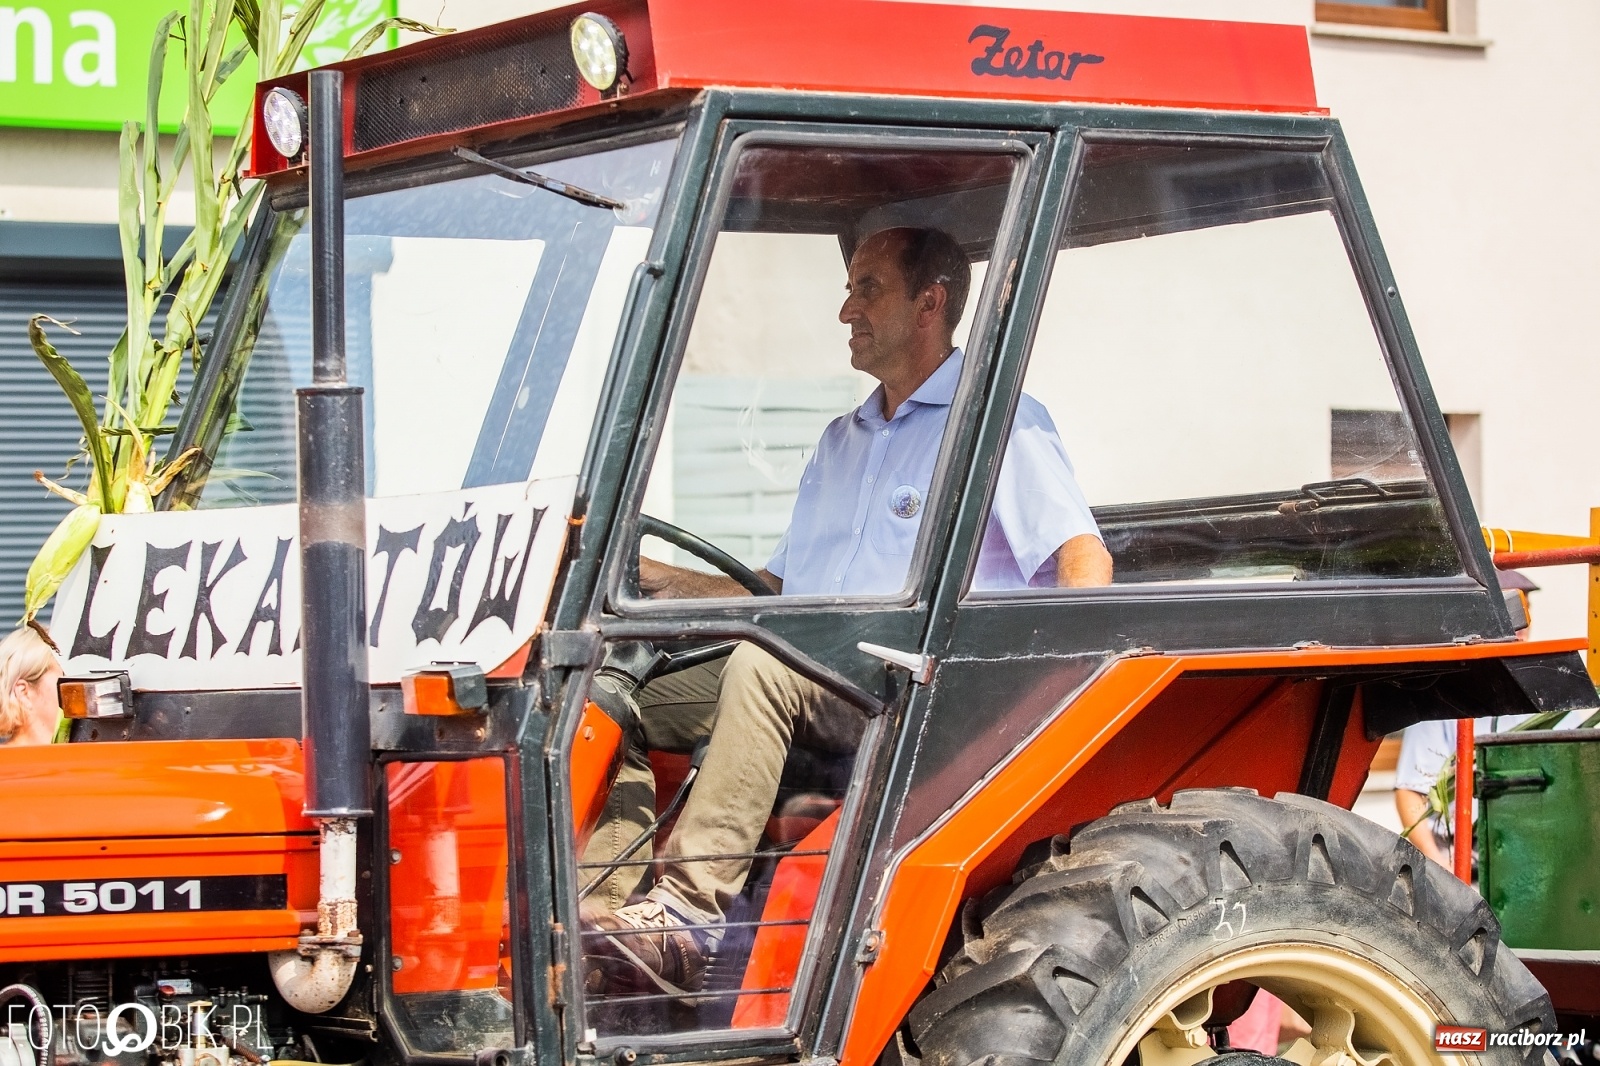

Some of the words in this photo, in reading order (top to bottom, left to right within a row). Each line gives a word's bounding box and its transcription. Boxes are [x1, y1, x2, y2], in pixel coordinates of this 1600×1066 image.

[69, 501, 549, 660] LEKATÓW
[0, 884, 45, 915] R
[63, 880, 201, 914] 5011
